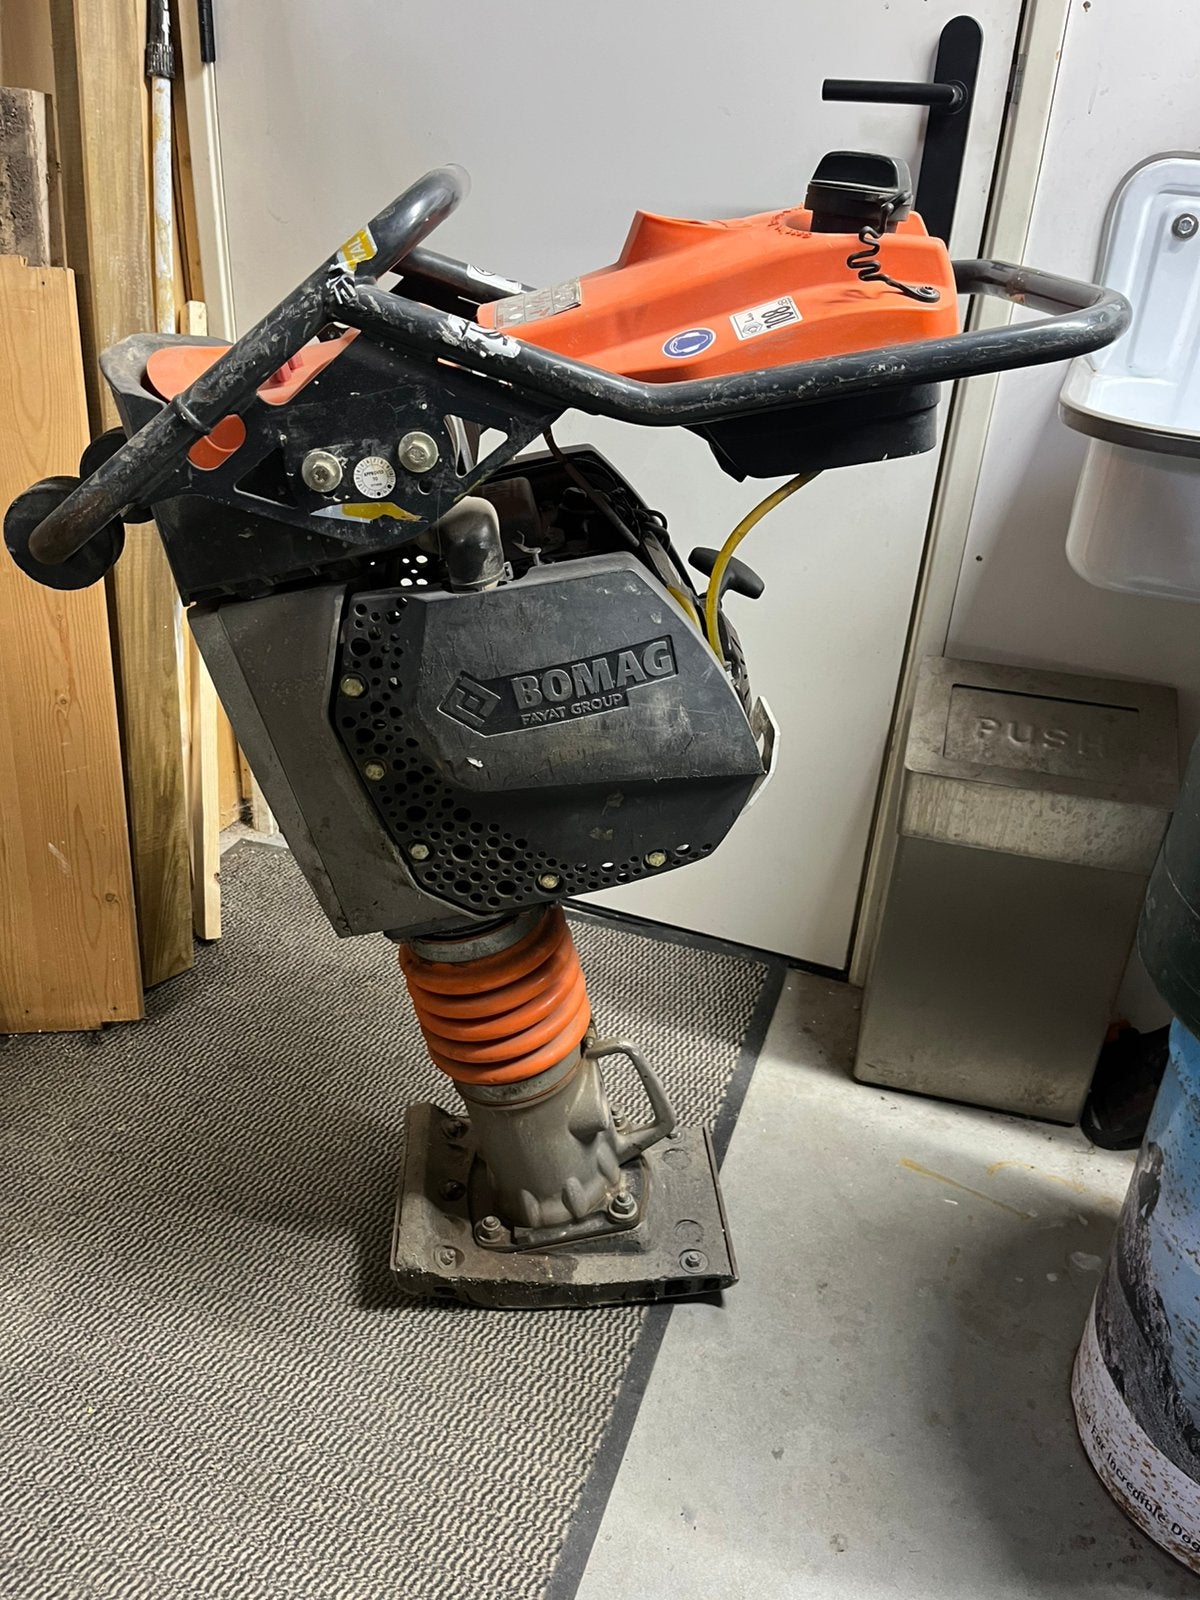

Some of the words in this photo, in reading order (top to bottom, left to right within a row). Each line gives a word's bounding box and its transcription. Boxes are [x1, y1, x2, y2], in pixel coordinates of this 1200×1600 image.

[761, 305, 796, 329] 108
[510, 640, 674, 710] BOMAG
[520, 705, 566, 726] FAYAT
[570, 693, 623, 715] GROUP
[1106, 1452, 1167, 1523] Incredible
